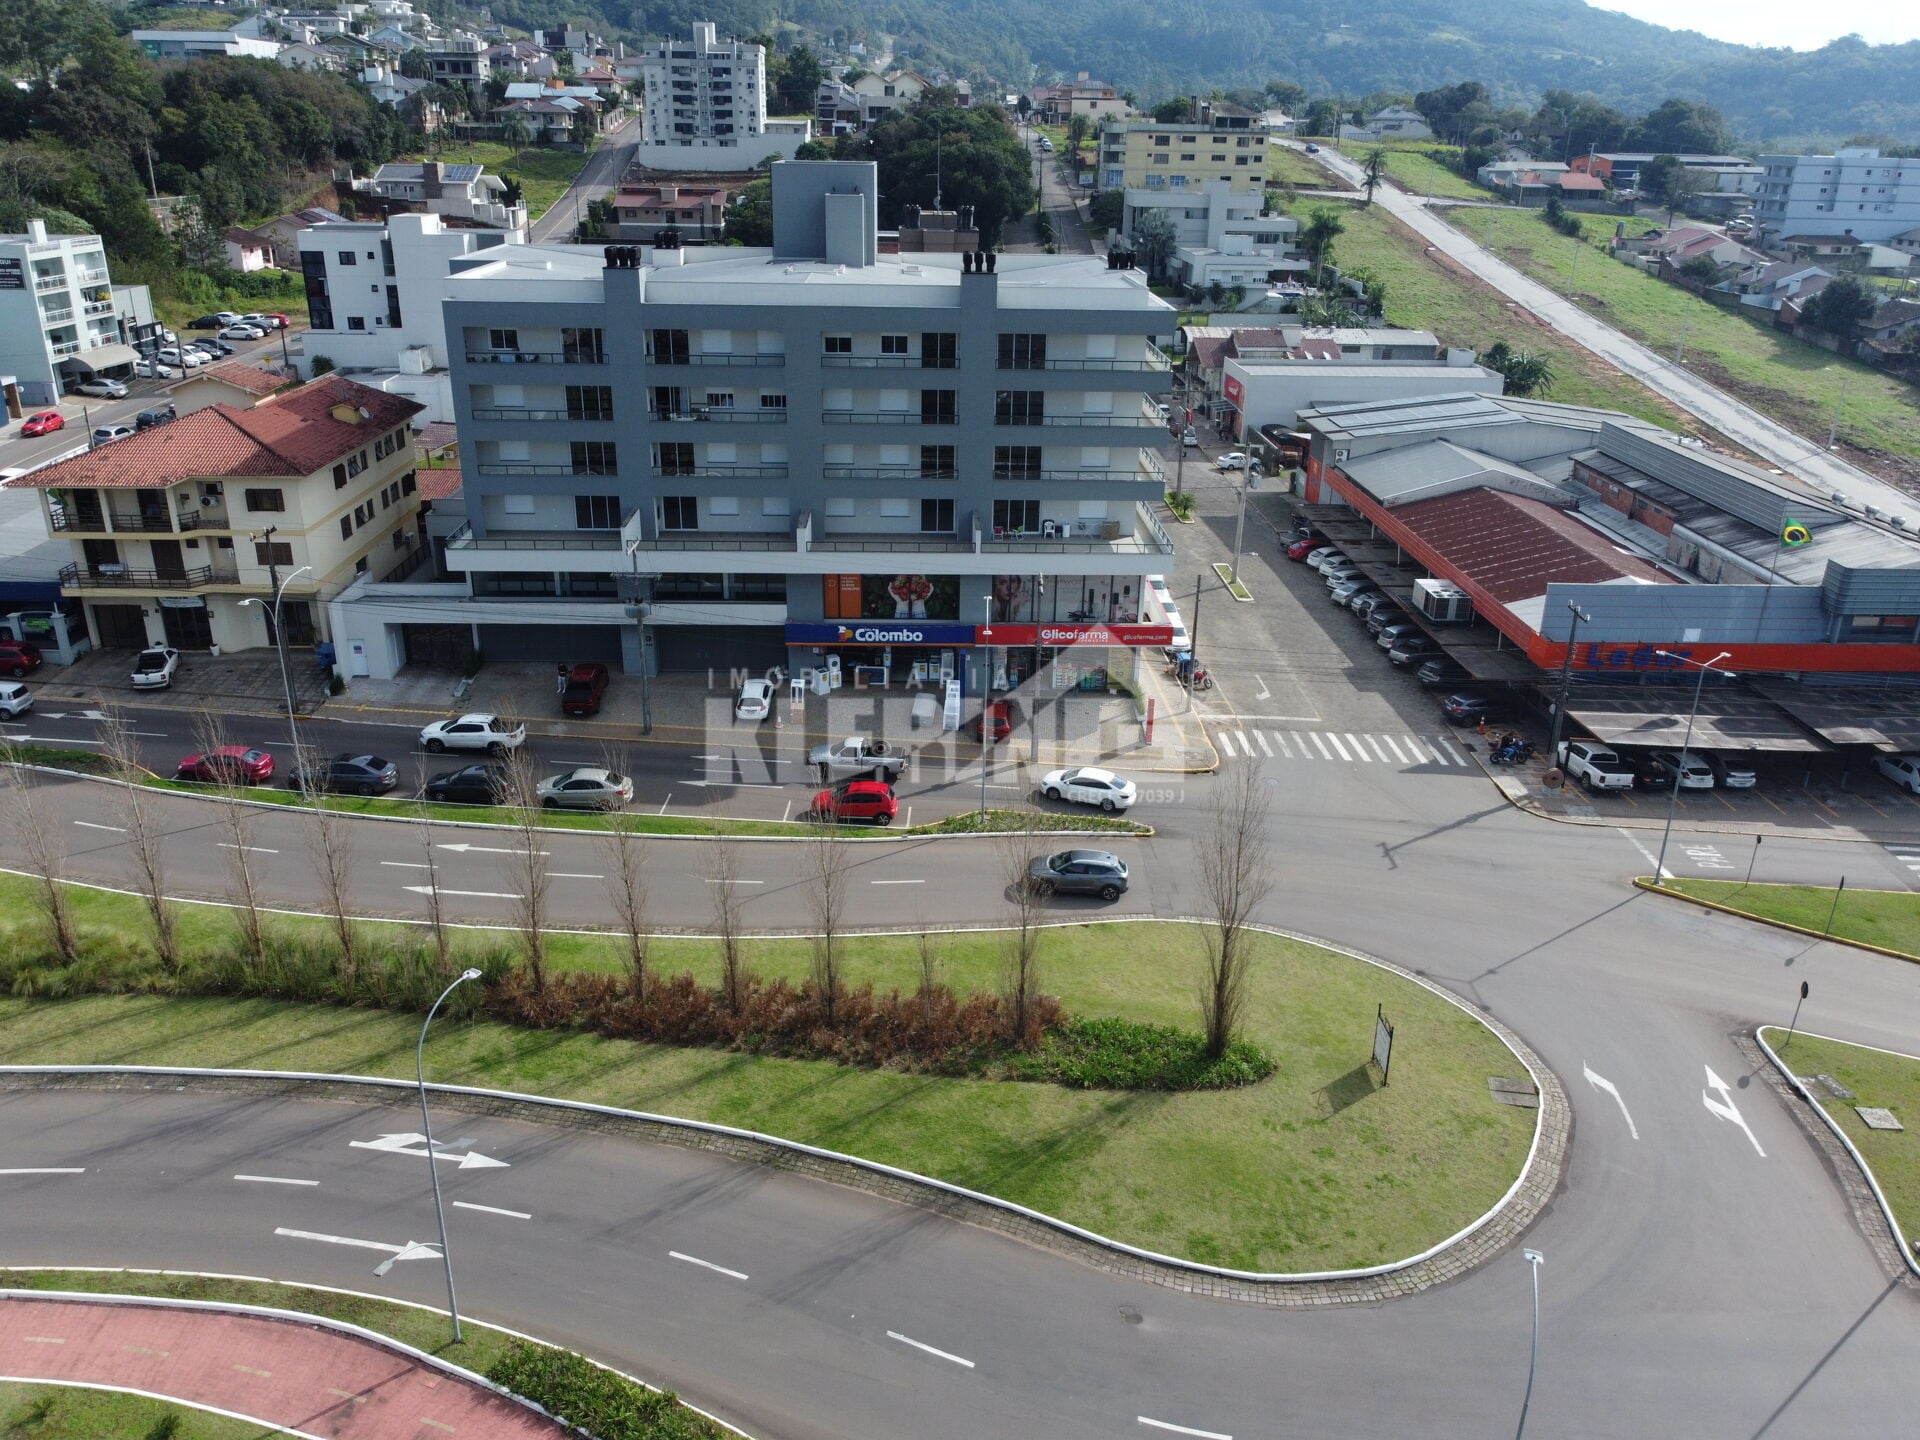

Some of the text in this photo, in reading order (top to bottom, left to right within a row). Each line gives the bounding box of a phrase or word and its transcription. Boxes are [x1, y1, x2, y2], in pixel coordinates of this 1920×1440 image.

[855, 628, 923, 642] Colombo
[1041, 628, 1109, 640] Glicofarma
[1587, 644, 1693, 667] Ledur
[1678, 843, 1736, 869] PARE
